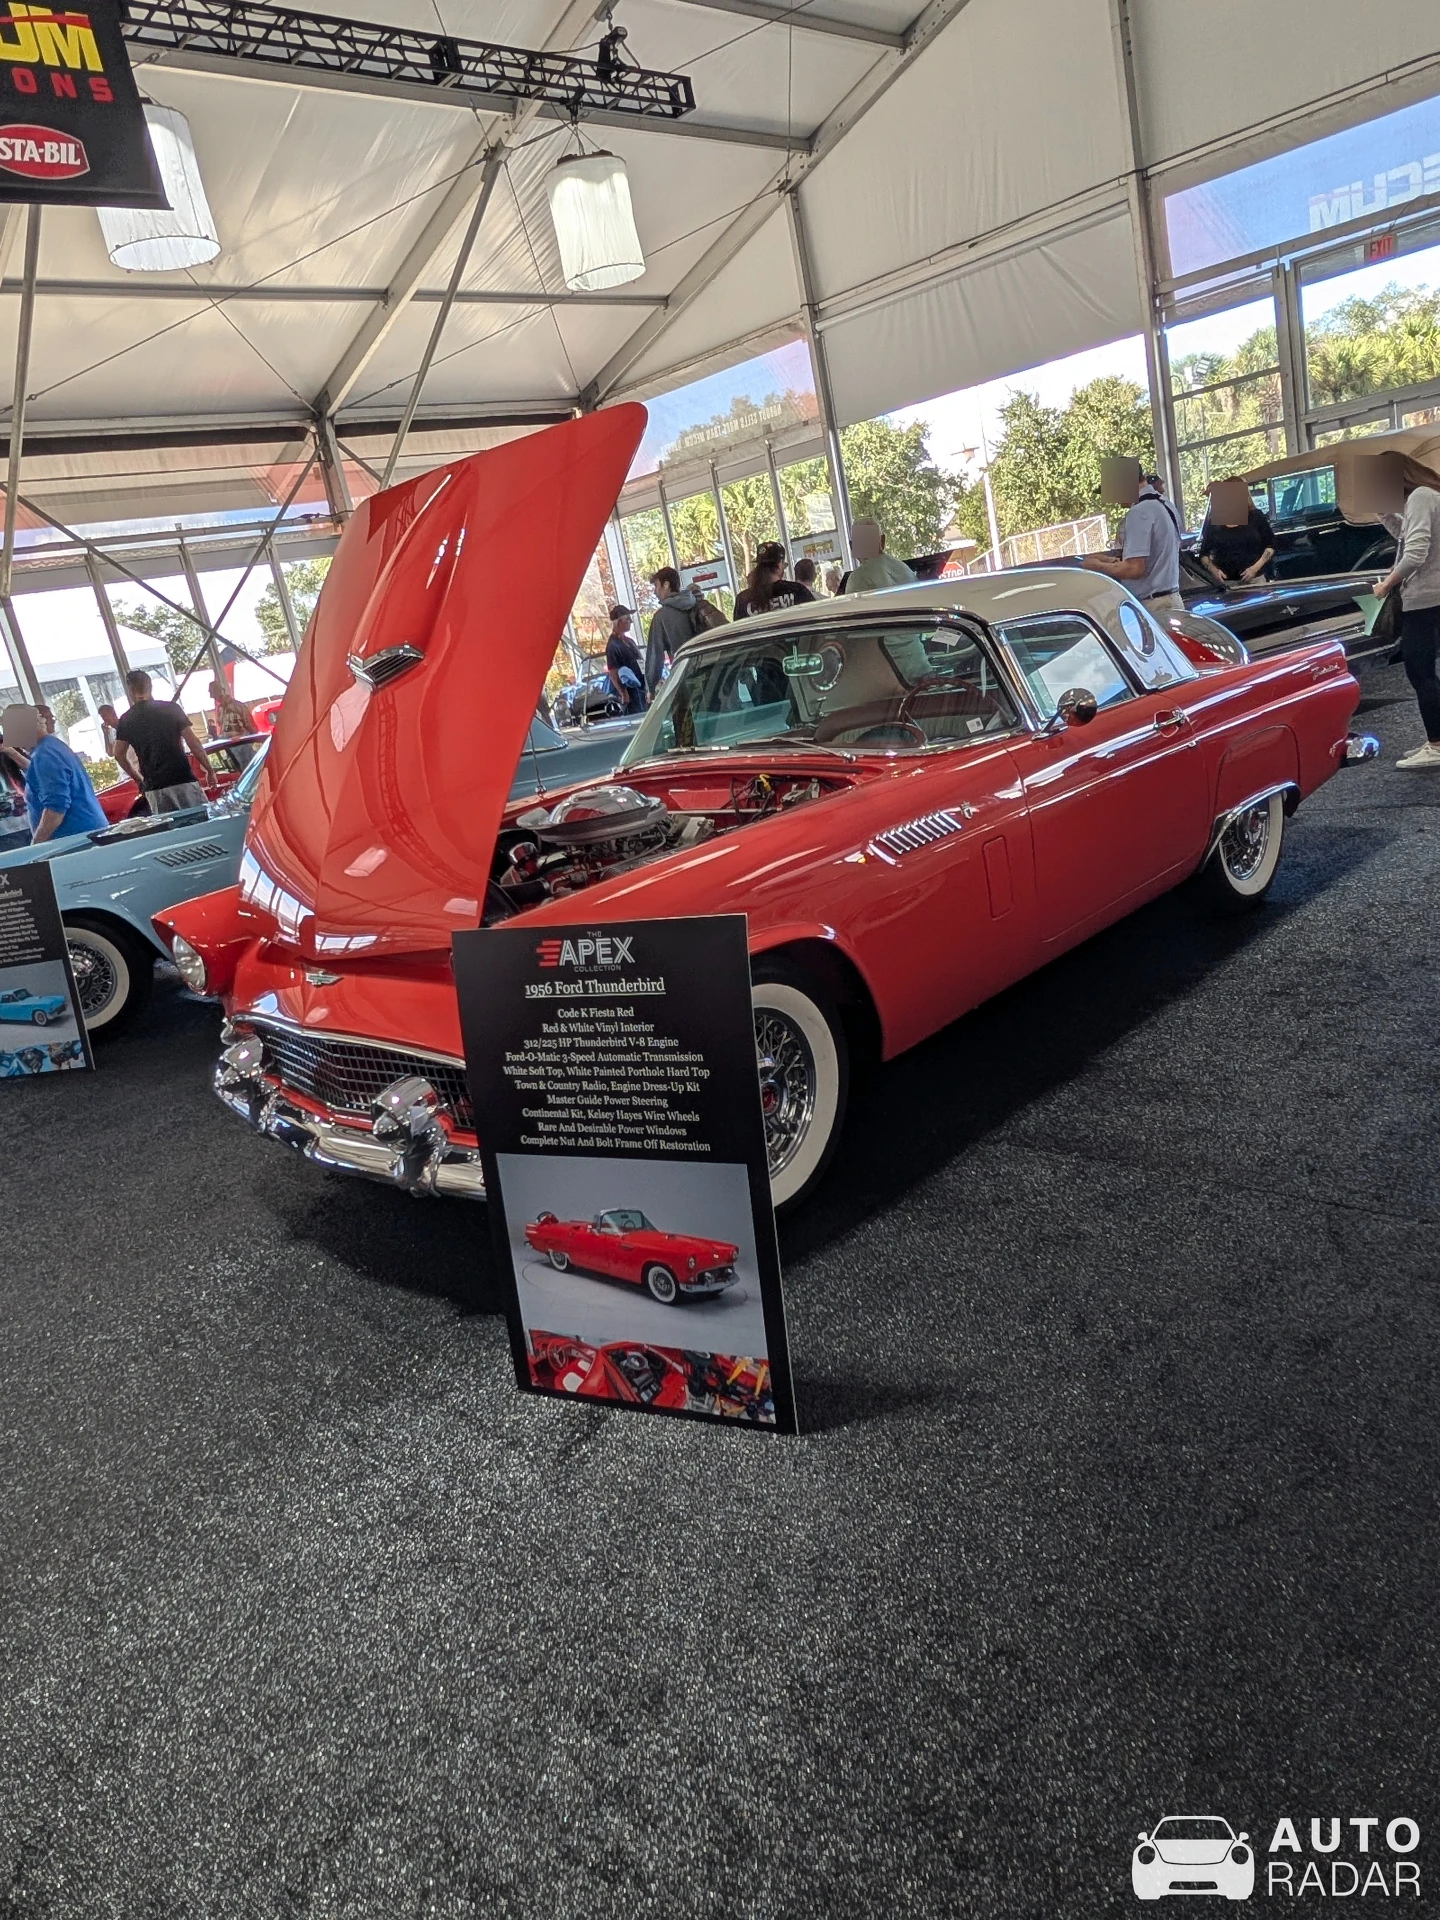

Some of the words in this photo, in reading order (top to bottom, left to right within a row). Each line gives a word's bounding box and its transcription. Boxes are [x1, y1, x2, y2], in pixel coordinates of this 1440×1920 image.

[11, 67, 114, 103] ONS
[0, 137, 81, 165] STA-BIL
[1370, 236, 1393, 260] EXIT
[747, 593, 795, 616] CEW
[559, 936, 636, 966] APEX
[574, 964, 621, 973] COLLECTION
[525, 981, 553, 996] 1956
[554, 979, 583, 994] Ford
[585, 977, 665, 993] Thunderbird
[557, 1008, 579, 1018] Code
[580, 1008, 588, 1018] K
[589, 1007, 615, 1017] Fiesta
[616, 1006, 634, 1017] Red
[542, 1022, 559, 1033] Red
[560, 1023, 568, 1033] &
[568, 1022, 595, 1032] White
[595, 1022, 618, 1034] Vinyl
[620, 1022, 655, 1032] Interior
[523, 1038, 557, 1049] 312/225
[558, 1037, 572, 1047] HP
[573, 1037, 627, 1047] Thunderbird
[628, 1037, 645, 1047] V-8
[647, 1037, 679, 1049] Engine
[505, 1051, 560, 1062] Ford-O-Matic
[562, 1051, 596, 1063] 3-Speed
[597, 1051, 641, 1062] Automatic
[642, 1051, 704, 1062] Transmission
[502, 1065, 528, 1075] White
[528, 1065, 545, 1076] Soft
[546, 1066, 565, 1078] Top,
[566, 1066, 592, 1076] White
[593, 1066, 626, 1076] Painted
[627, 1066, 665, 1076] Porthole
[666, 1066, 690, 1077] Hard
[691, 1067, 710, 1079] Top
[514, 1080, 538, 1090] Town
[539, 1080, 546, 1090] &
[547, 1081, 580, 1092] Country
[581, 1081, 610, 1091] Radio,
[611, 1081, 641, 1093] Engine
[642, 1082, 684, 1094] Dress-Up
[686, 1082, 700, 1092] Kit
[546, 1094, 576, 1104] Master
[577, 1095, 602, 1105] Guide
[603, 1095, 630, 1105] Power
[631, 1096, 669, 1108] Steering
[522, 1108, 569, 1118] Continental
[570, 1108, 586, 1119] Kit,
[587, 1109, 615, 1121] Kelsey
[616, 1110, 642, 1122] Hayes
[643, 1110, 666, 1120] Wire
[666, 1111, 700, 1121] Wheels
[537, 1122, 557, 1132] Rare
[558, 1122, 576, 1132] And
[577, 1123, 616, 1133] Desirable
[617, 1124, 644, 1134] Power
[645, 1125, 687, 1136] Windows
[520, 1135, 559, 1147] Complete
[560, 1136, 576, 1146] Nut
[577, 1137, 595, 1147] And
[596, 1137, 613, 1147] Bolt
[614, 1138, 642, 1148] Frame
[643, 1139, 658, 1149] Off
[659, 1140, 711, 1151] Restoration
